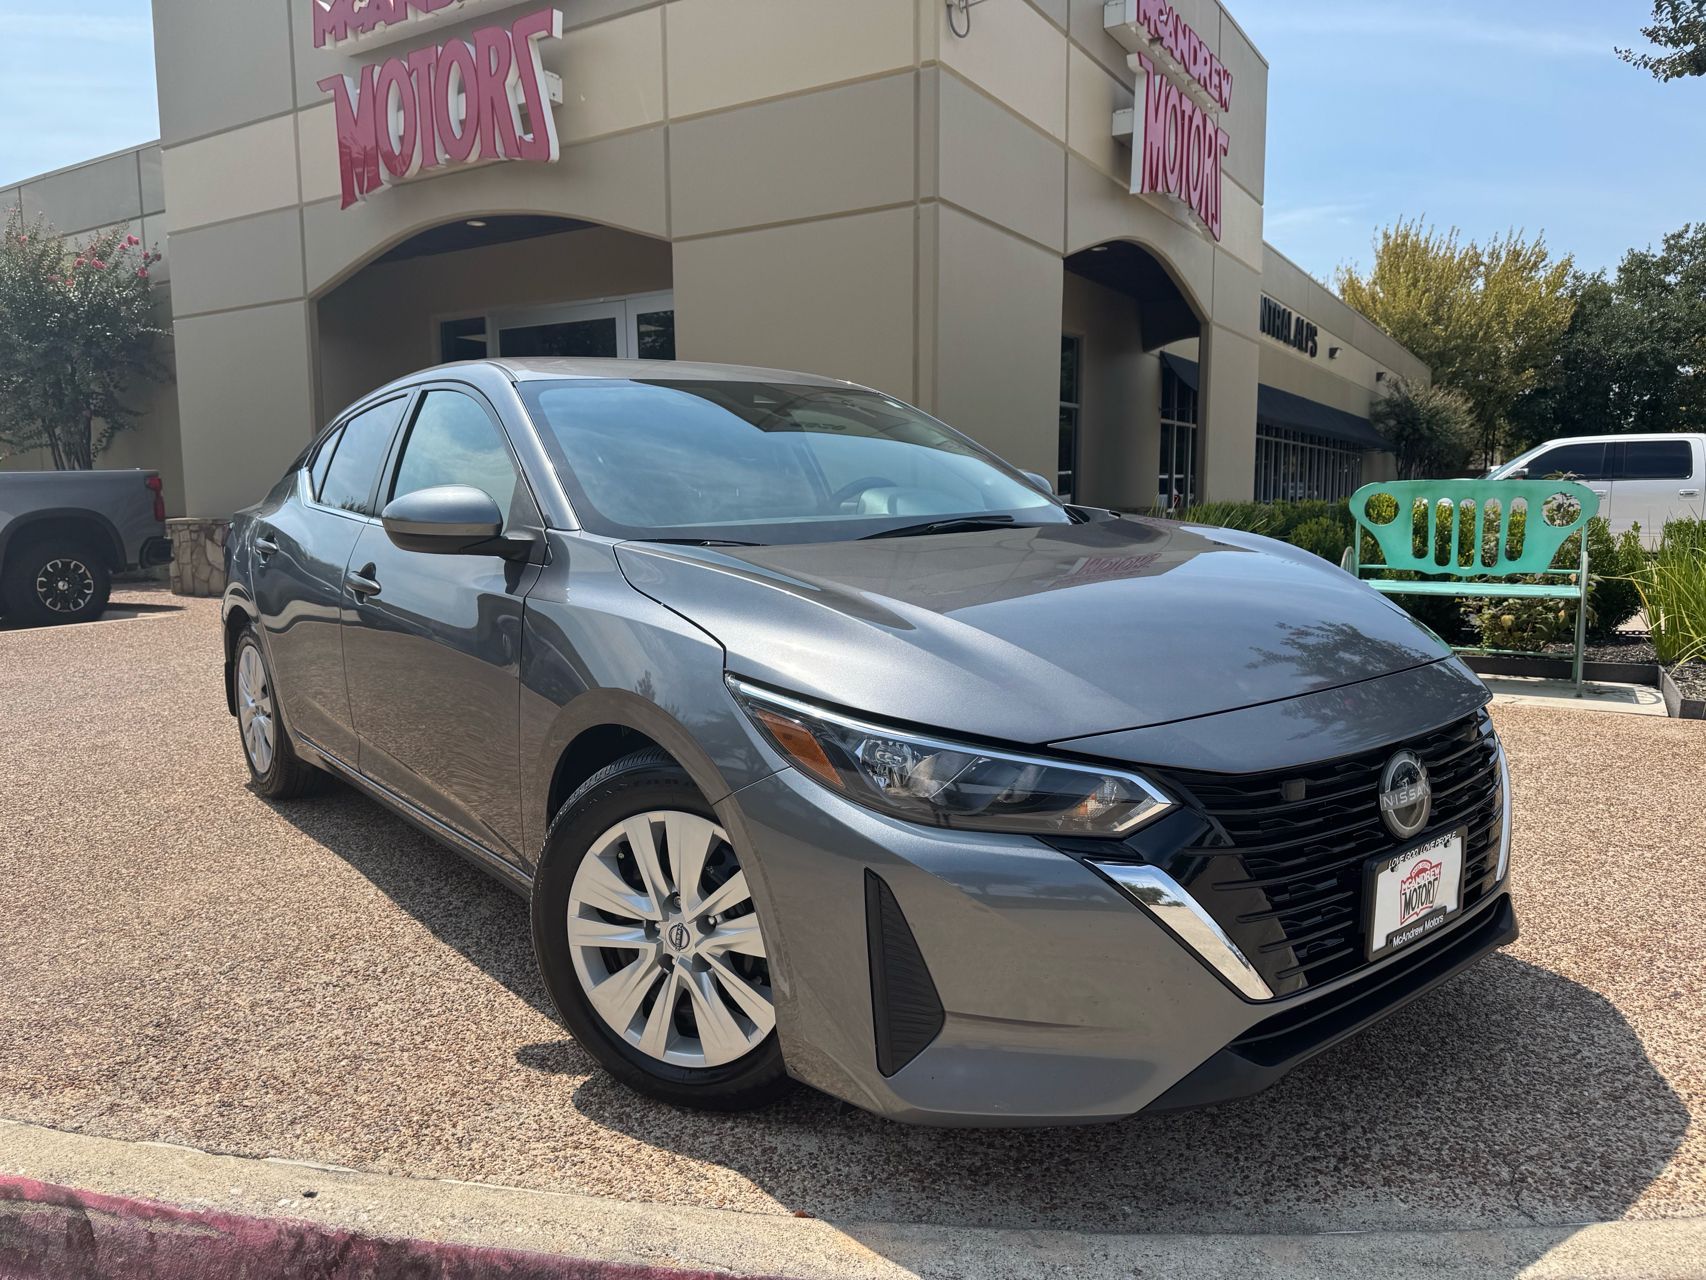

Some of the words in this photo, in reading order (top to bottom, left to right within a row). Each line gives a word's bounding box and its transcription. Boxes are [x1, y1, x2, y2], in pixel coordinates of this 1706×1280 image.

[317, 8, 555, 210] MOTORS
[1137, 51, 1230, 242] MOTORS
[1383, 783, 1431, 808] NISSAN
[1402, 877, 1439, 920] MOTORS
[1392, 925, 1424, 948] McAndrew
[1424, 914, 1444, 931] Motors
